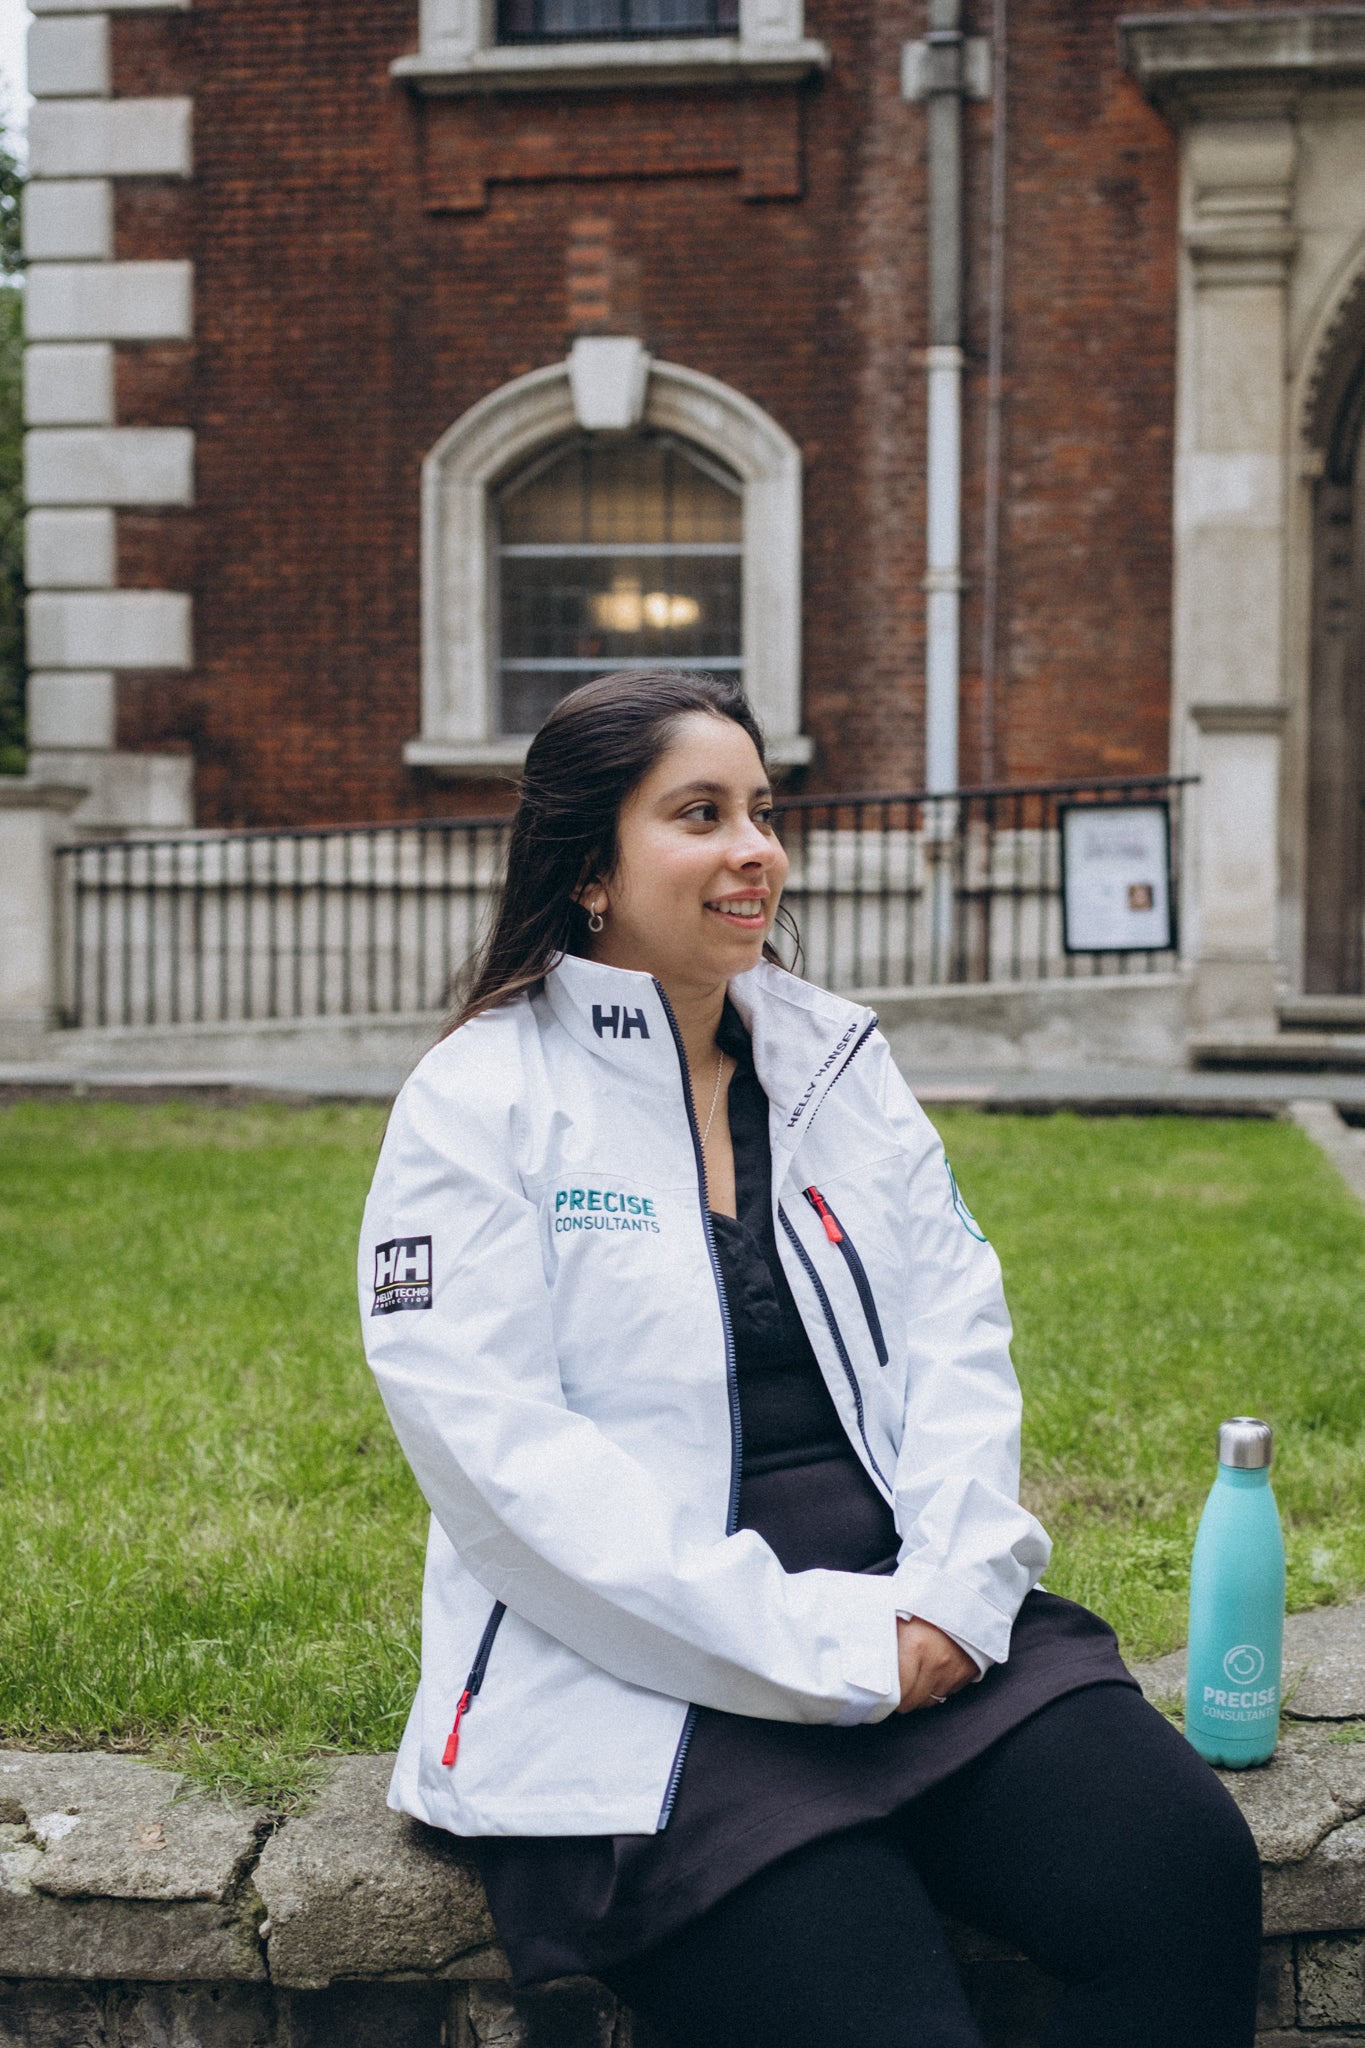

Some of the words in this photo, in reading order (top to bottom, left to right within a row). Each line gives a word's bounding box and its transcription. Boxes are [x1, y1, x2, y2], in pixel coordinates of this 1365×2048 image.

[591, 1004, 650, 1039] HH
[787, 1082, 816, 1128] HELLY
[815, 1023, 858, 1077] HANSEN
[555, 1188, 656, 1217] PRECISE
[555, 1216, 661, 1234] CONSULTANTS
[375, 1244, 429, 1288] HH
[1203, 1686, 1276, 1709] PRECISE
[1202, 1705, 1276, 1721] CONSULTANTS
